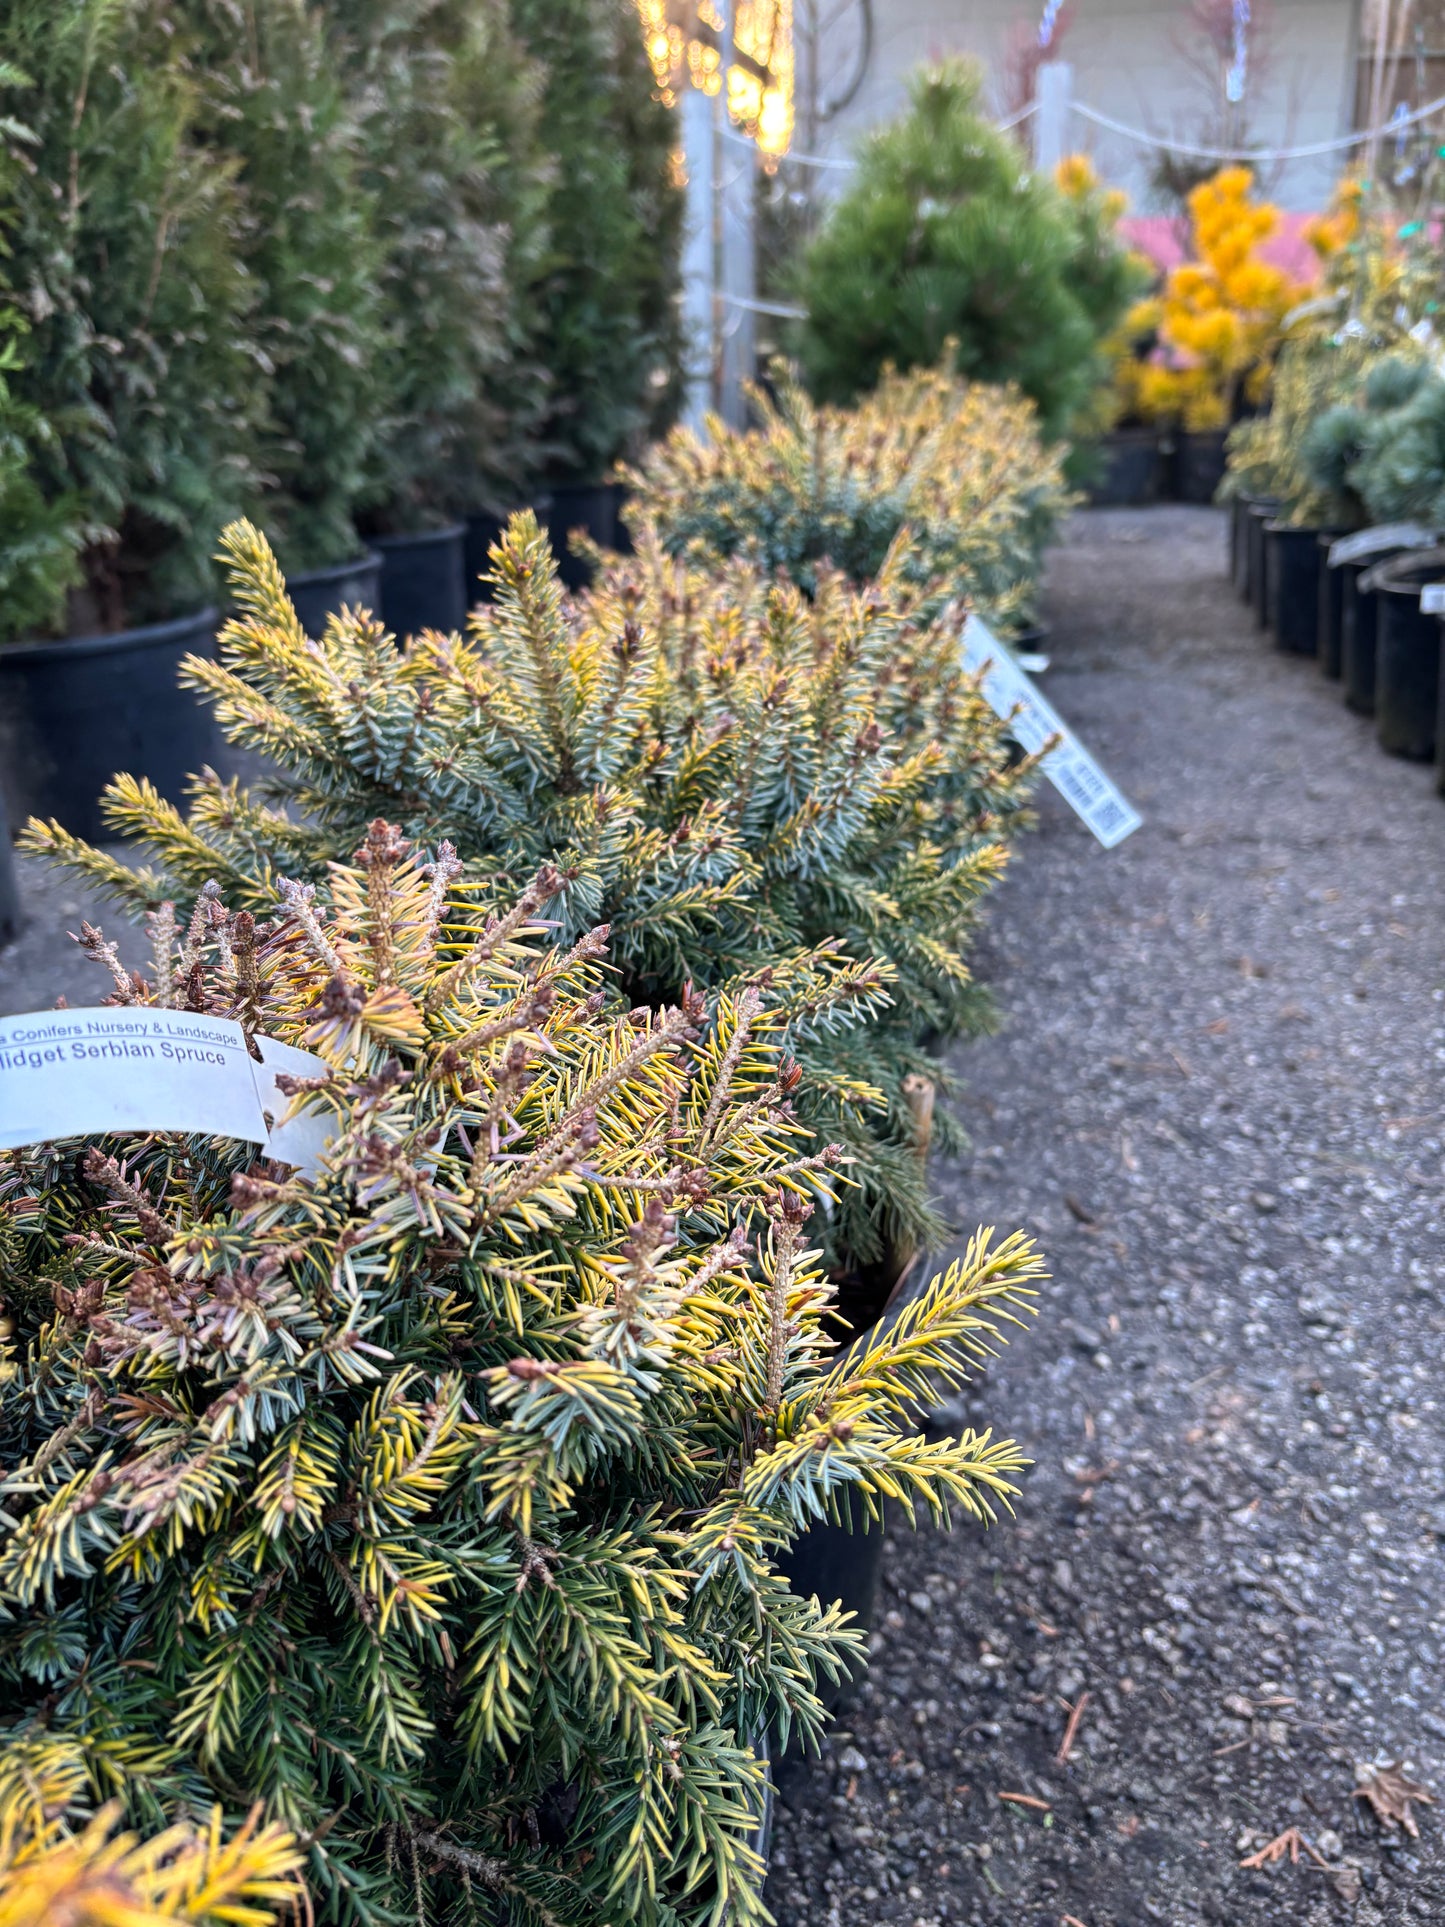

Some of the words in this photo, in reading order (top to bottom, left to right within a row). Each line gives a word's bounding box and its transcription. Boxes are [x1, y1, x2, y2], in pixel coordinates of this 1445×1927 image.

[12, 1023, 82, 1042] Conifers
[87, 1020, 148, 1037] Nursery
[153, 1021, 164, 1034] &
[167, 1023, 238, 1046] Landscape
[0, 1045, 65, 1071] idget
[71, 1039, 155, 1060] Serbian
[160, 1042, 226, 1066] Spruce
